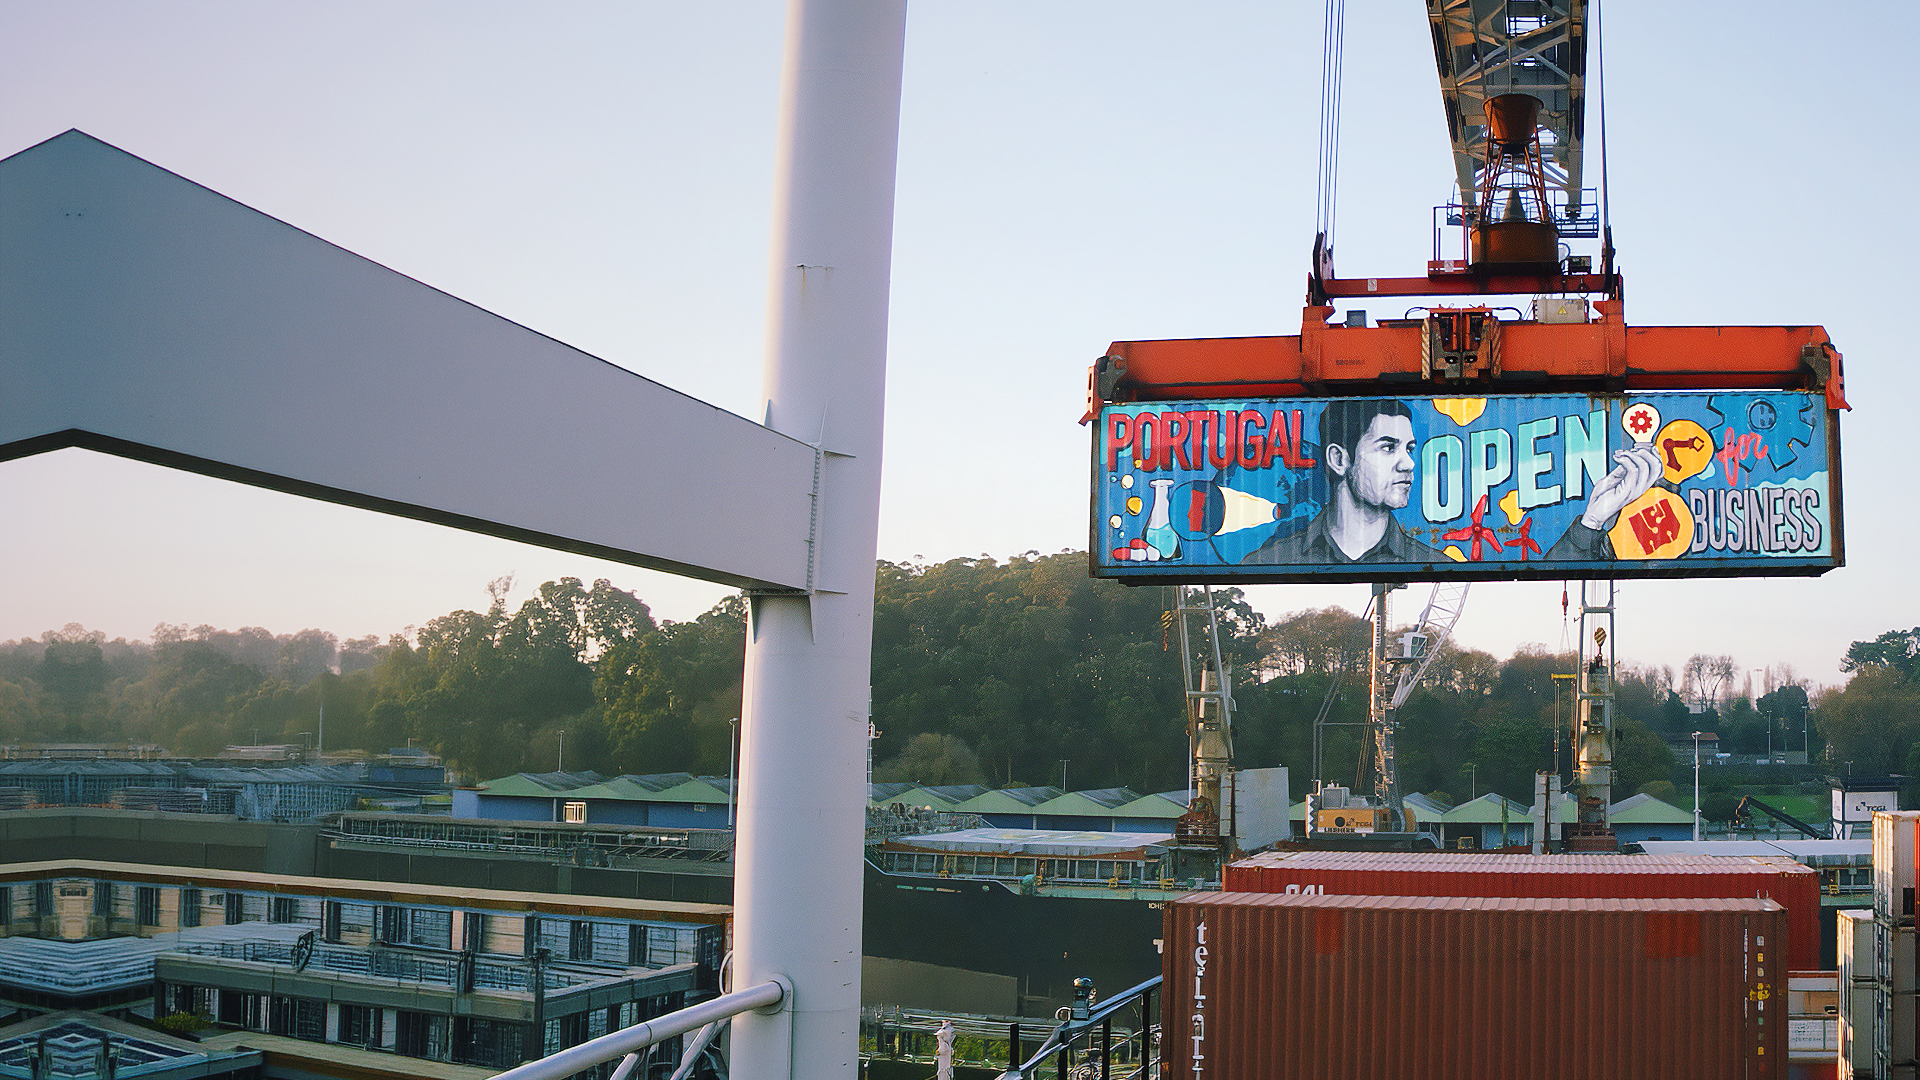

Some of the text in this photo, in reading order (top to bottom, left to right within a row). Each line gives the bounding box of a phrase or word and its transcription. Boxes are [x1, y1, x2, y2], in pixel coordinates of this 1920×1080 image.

[1107, 409, 1317, 473] PORTUGAL
[1421, 409, 1609, 524] OPEN
[1716, 427, 1769, 487] for
[1690, 487, 1822, 553] BUSINESS
